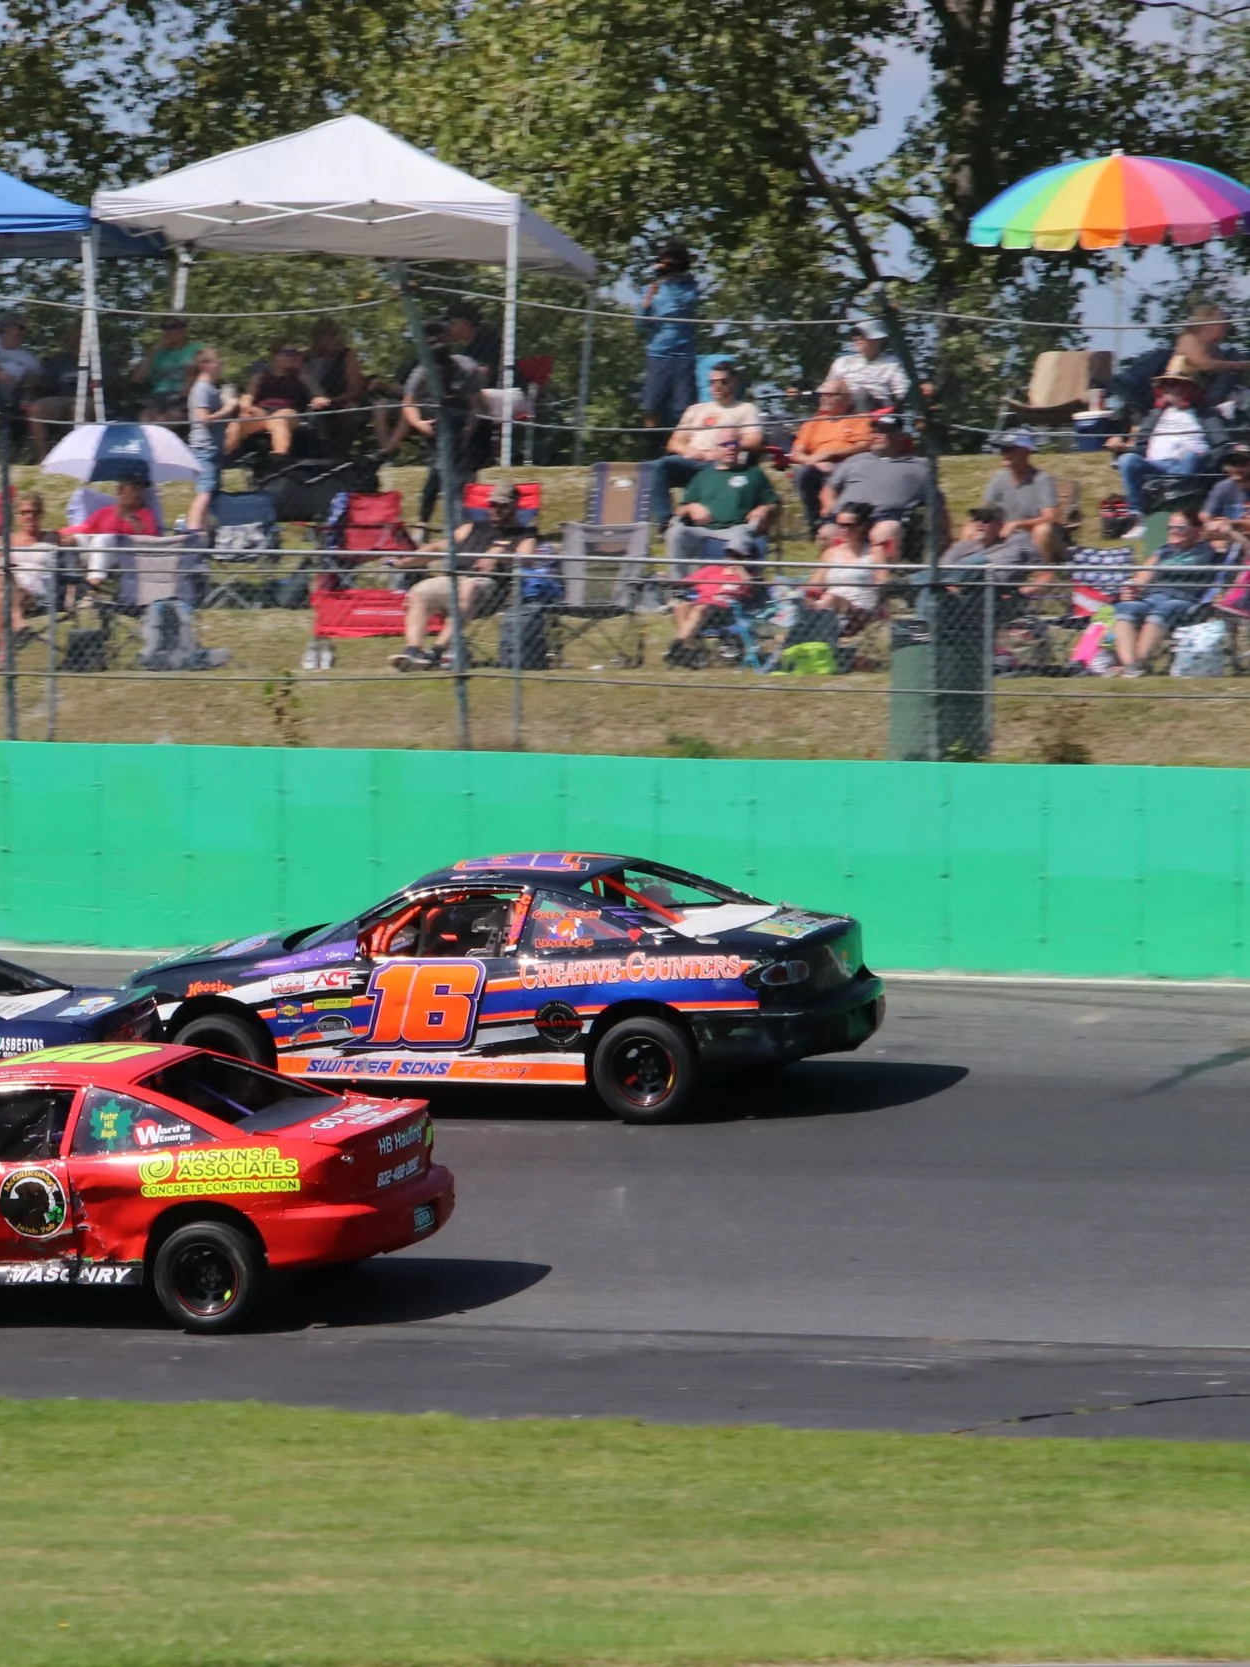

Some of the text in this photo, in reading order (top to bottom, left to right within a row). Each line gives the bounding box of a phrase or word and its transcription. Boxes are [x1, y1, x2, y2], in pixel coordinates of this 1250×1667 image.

[519, 952, 742, 989] CREATIVE COUNTERS
[313, 971, 351, 987] ACT
[185, 979, 234, 998] Hoosier
[366, 960, 486, 1048] 16
[0, 1038, 45, 1052] ASBESTOS
[397, 1061, 450, 1075] SONS
[136, 1124, 191, 1146] Ward's
[159, 1133, 191, 1143] Energy
[378, 1136, 393, 1156] HB
[181, 1149, 277, 1163] HASKINS &
[179, 1160, 297, 1177] ASSOCIATES
[142, 1180, 297, 1196] CONCRETE CONSTRUCTION
